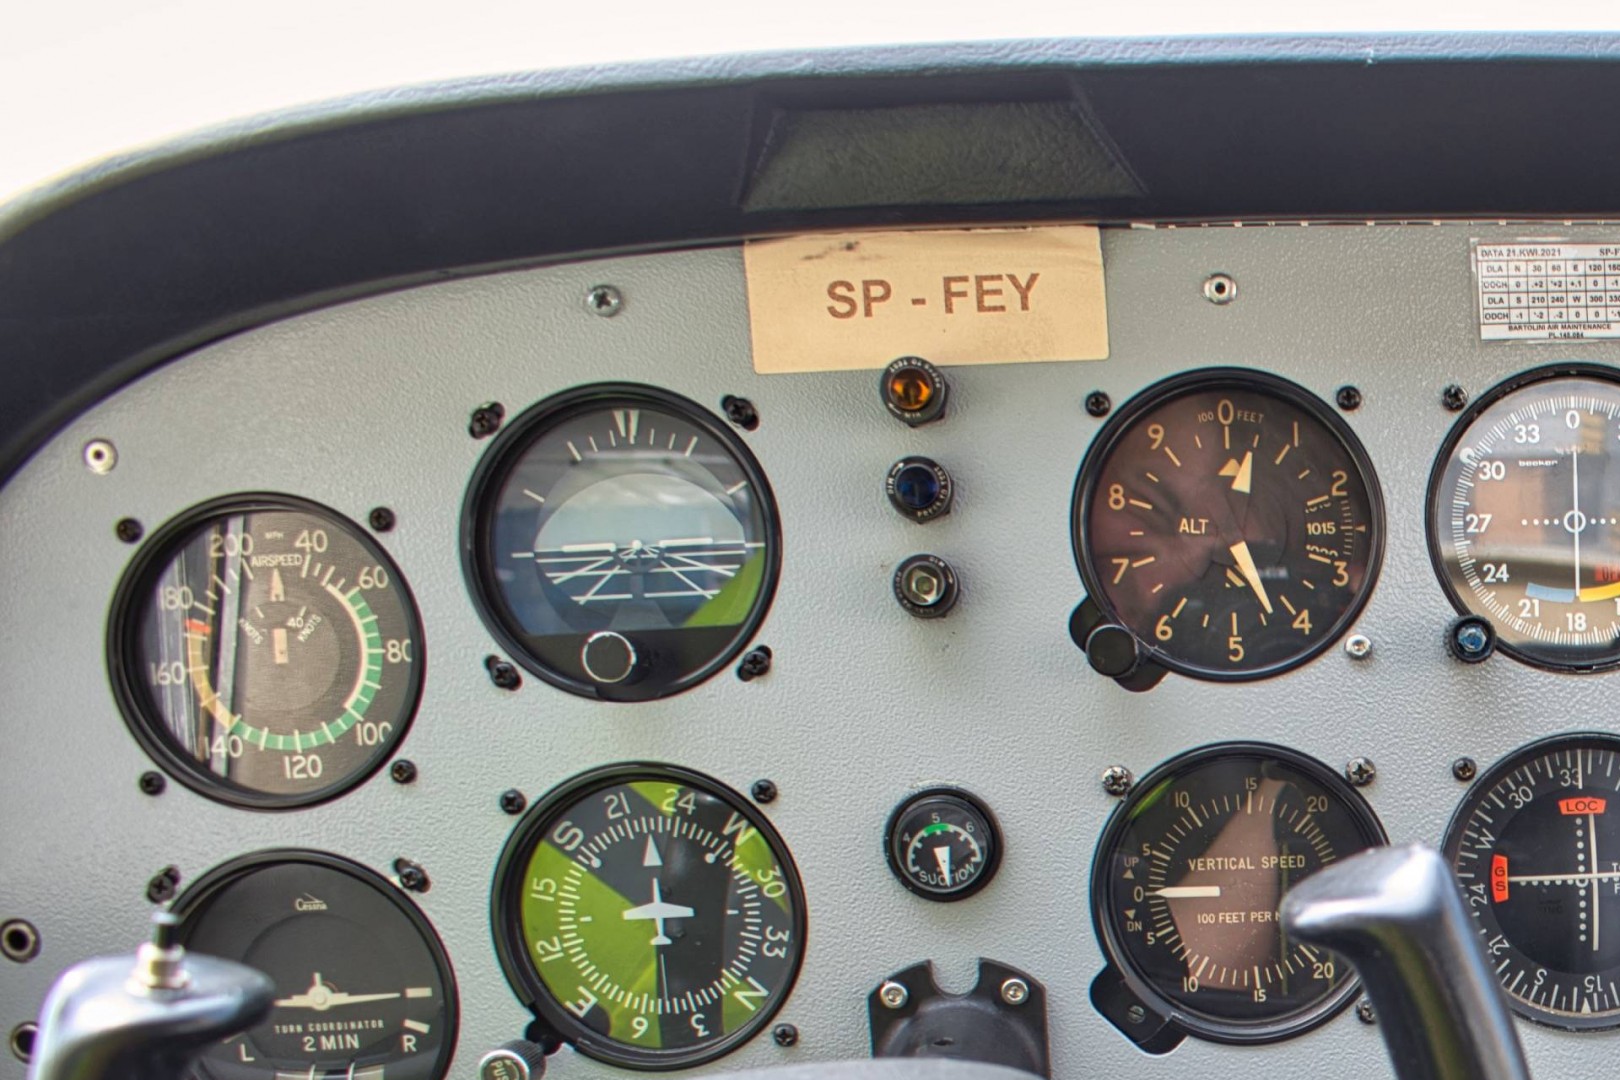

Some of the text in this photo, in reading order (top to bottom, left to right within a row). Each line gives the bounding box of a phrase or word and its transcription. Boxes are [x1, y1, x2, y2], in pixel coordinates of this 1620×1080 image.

[827, 280, 891, 318] SP
[943, 273, 1039, 313] FEY
[1218, 400, 1234, 424] 0
[1237, 410, 1264, 423] FEET
[1515, 425, 1540, 443] 33
[1479, 461, 1505, 480] 30
[1180, 518, 1208, 534] ALT
[1307, 522, 1336, 535] 1015
[1466, 514, 1492, 533] 27
[252, 554, 302, 566] AIRSPEED
[1483, 564, 1509, 583] 24
[1519, 599, 1539, 617] 21
[1566, 800, 1598, 812] LOC
[1124, 857, 1139, 868] UP
[1188, 855, 1305, 871] VERTICAL SPEED
[296, 898, 327, 911] Cessna
[1198, 912, 1272, 924] 100 FEET PER
[1127, 921, 1142, 932] DN
[274, 1020, 384, 1034] TURN COORDINATOR
[304, 1034, 359, 1051] 2 MIN
[403, 1036, 416, 1052] R
